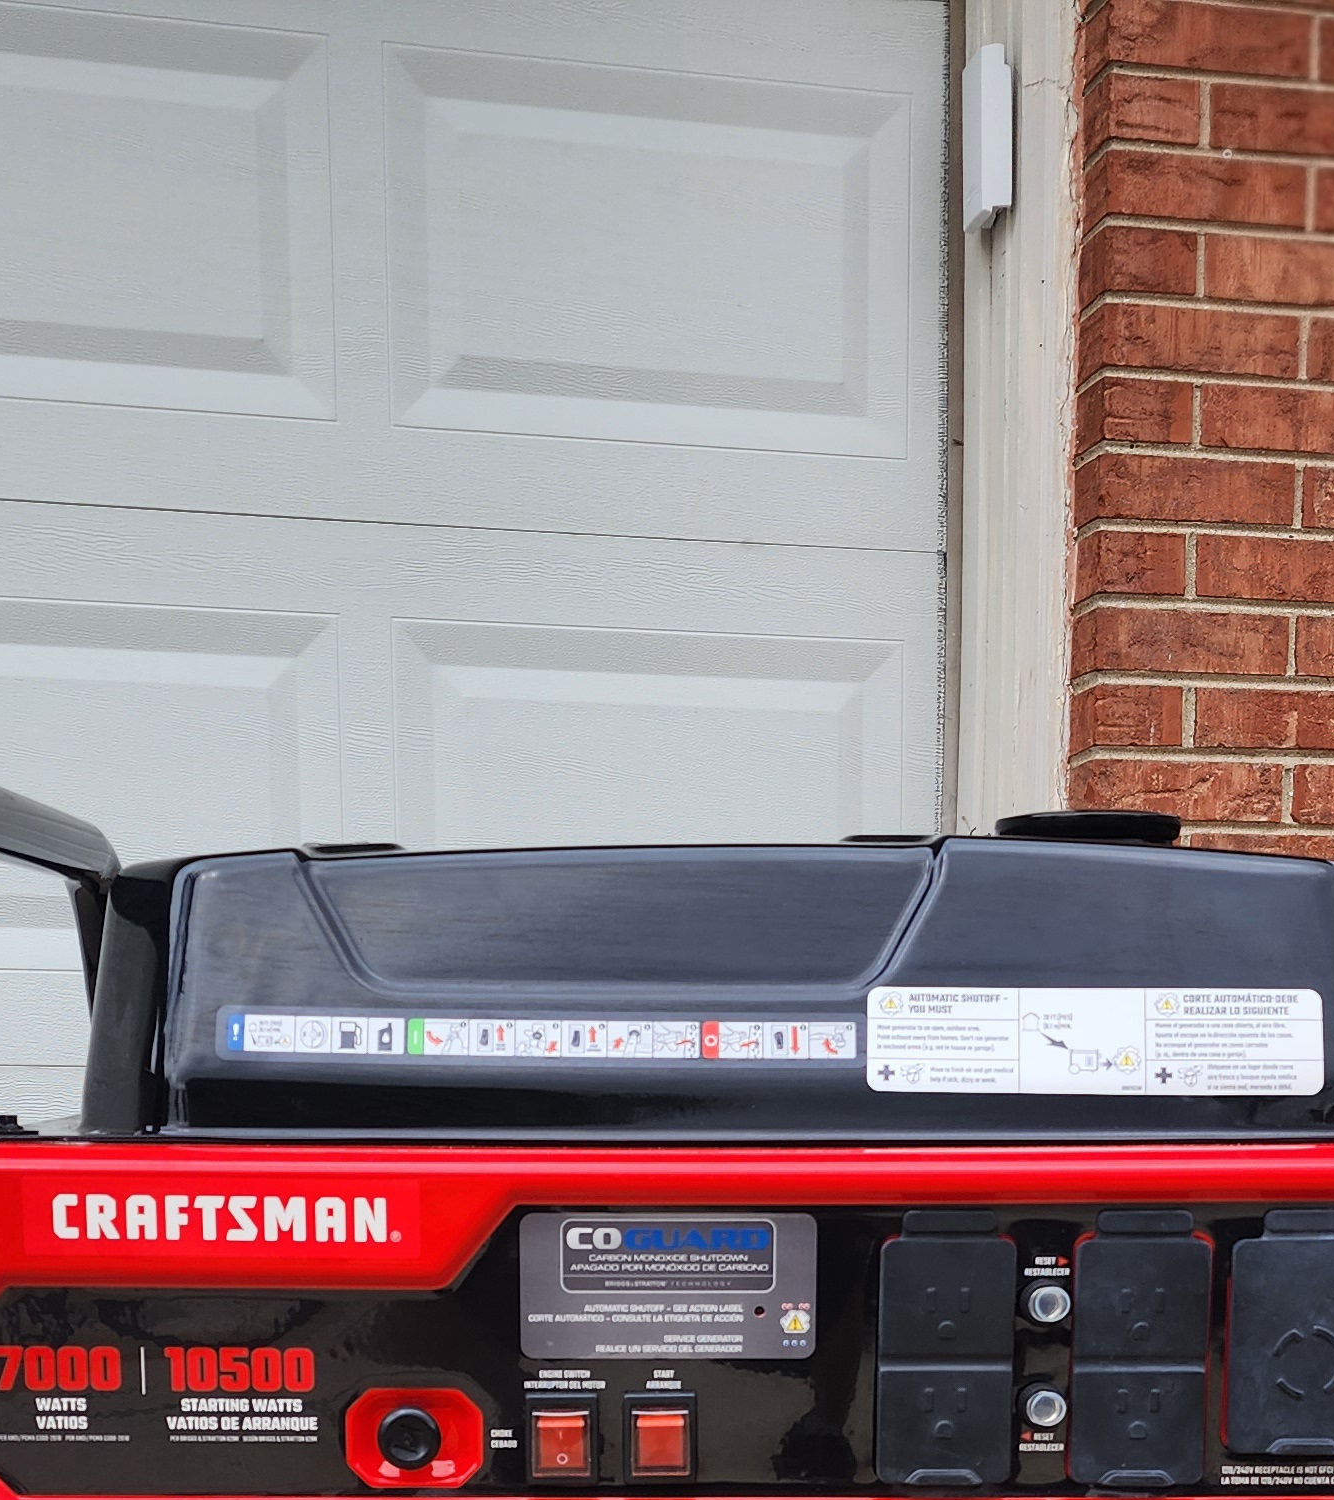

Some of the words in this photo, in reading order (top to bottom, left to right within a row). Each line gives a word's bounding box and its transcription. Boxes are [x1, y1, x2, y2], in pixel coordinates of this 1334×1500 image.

[909, 993, 958, 1002] AUTOMATIC
[961, 994, 1000, 1003] SHUTOFF
[1183, 994, 1211, 1003] CORTE
[909, 1005, 925, 1013] YOU
[929, 1005, 952, 1014] MUST
[1184, 1006, 1227, 1015] REALIZAR
[1230, 1006, 1240, 1015] LO
[1243, 1006, 1288, 1015] SIGUIENTE
[589, 1254, 631, 1262] CARBON
[634, 1254, 687, 1262] MONOXIDE
[690, 1254, 748, 1262] SHUTDOWN
[571, 1263, 619, 1271] APAGADO
[645, 1263, 700, 1271] MONÓXIDO
[703, 1263, 716, 1271] DE
[719, 1263, 769, 1271] CARBONO
[584, 1304, 628, 1312] AUTOMATIC
[630, 1304, 665, 1312] SHUTOFF
[689, 1304, 718, 1312] ACTION
[719, 1304, 743, 1312] LABEL
[528, 1314, 553, 1322] CORTE
[611, 1313, 652, 1322] CONSULTE
[652, 1313, 663, 1322] LA
[701, 1313, 713, 1322] DE
[664, 1335, 695, 1343] SERVICE
[697, 1335, 743, 1343] GENERATOR
[595, 1345, 627, 1353] REALICE
[629, 1345, 641, 1353] UN
[642, 1345, 677, 1353] SERVICIO
[678, 1345, 693, 1353] DEL
[695, 1344, 742, 1353] GENERADOR
[164, 1347, 315, 1392] 10500
[35, 1397, 87, 1412] WATTS
[181, 1398, 249, 1413] STARTING
[252, 1398, 302, 1413] WATTS
[35, 1416, 88, 1430] VATIOS
[166, 1416, 218, 1430] VATIOS
[220, 1416, 240, 1430] DE
[242, 1416, 318, 1431] ARRANQUE
[1255, 1466, 1294, 1474] RECEPTACLE
[1221, 1477, 1230, 1485] LA
[1304, 1476, 1329, 1485] CUENTA
